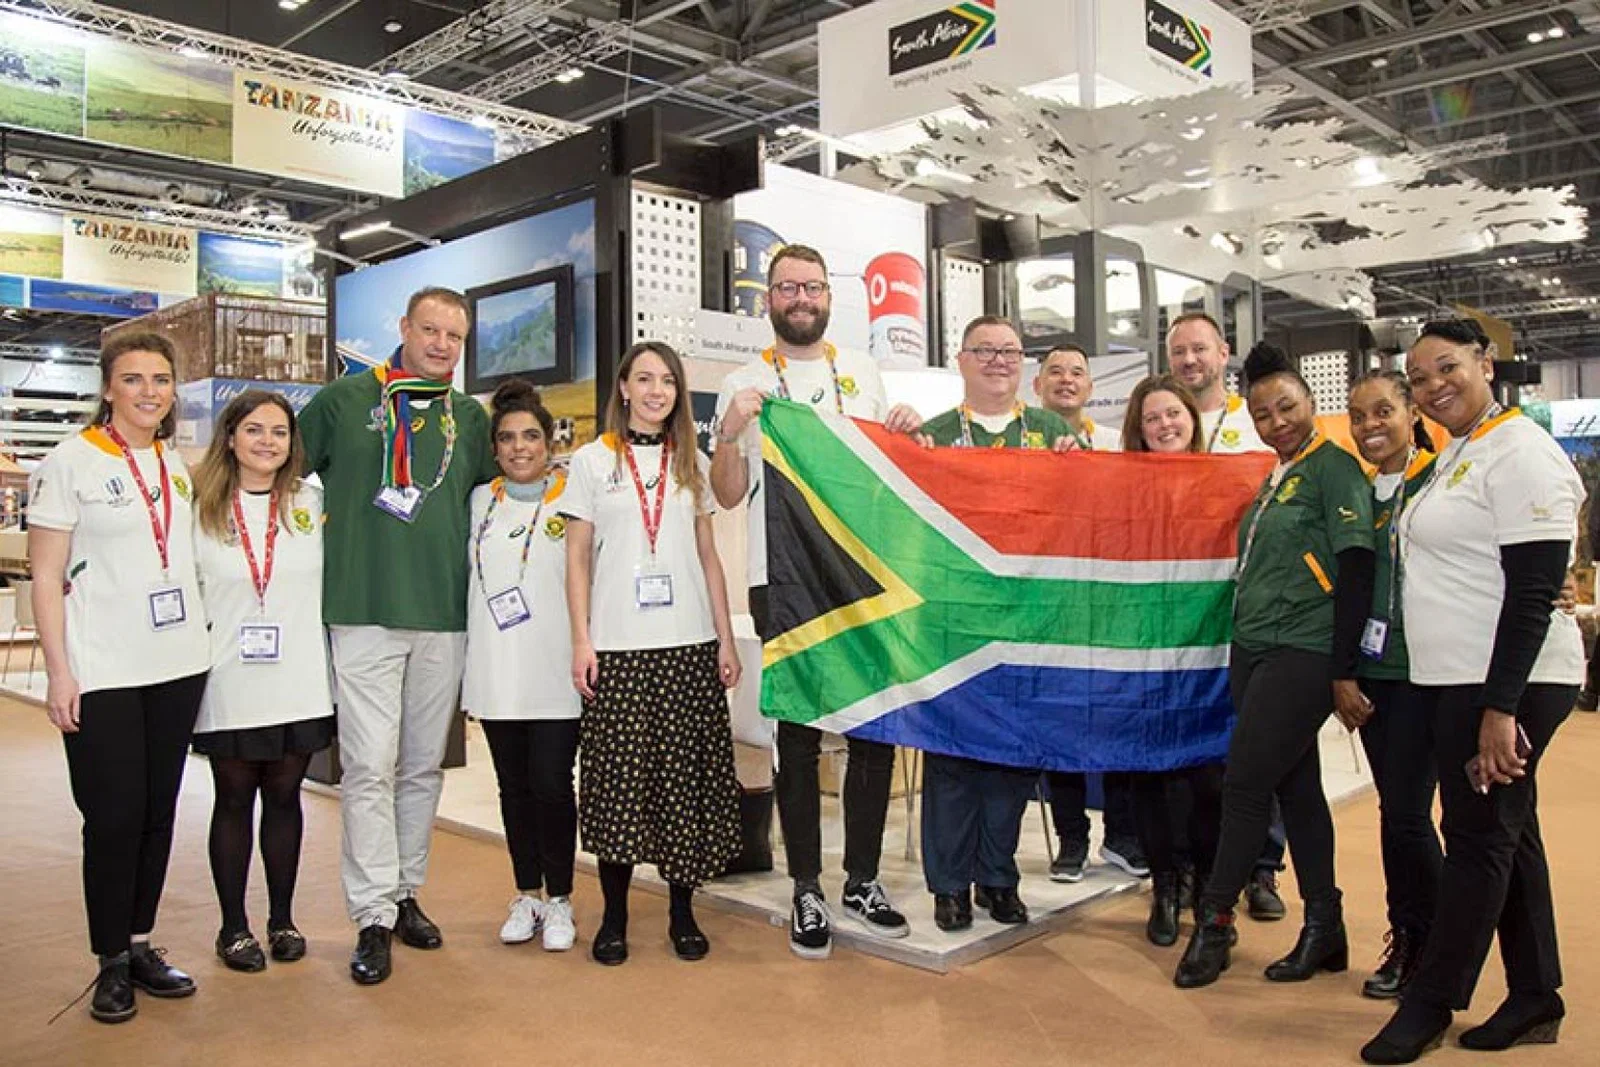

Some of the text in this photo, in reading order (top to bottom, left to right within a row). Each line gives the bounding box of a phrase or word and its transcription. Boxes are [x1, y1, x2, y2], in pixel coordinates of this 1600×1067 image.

[892, 18, 968, 60] South Africa
[244, 80, 394, 135] TANZANIA
[72, 218, 190, 252] TANZANIA
